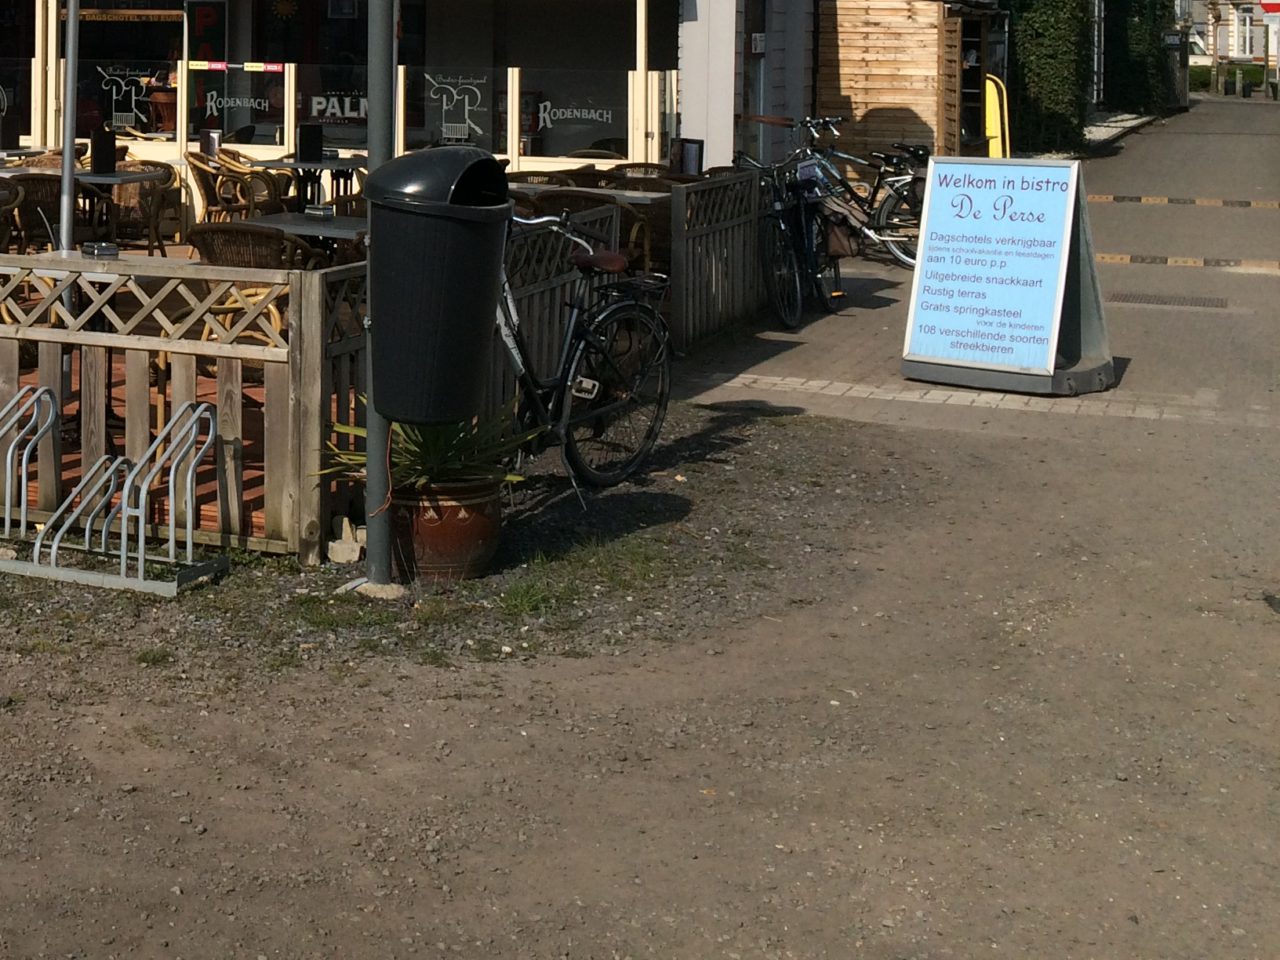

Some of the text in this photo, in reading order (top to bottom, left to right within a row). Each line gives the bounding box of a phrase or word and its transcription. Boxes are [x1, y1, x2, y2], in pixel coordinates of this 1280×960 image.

[85, 14, 138, 22] DAGSCHOTEL
[205, 91, 269, 119] RODENBACH
[537, 101, 612, 131] RODENBACH
[938, 173, 1069, 192] Welkom in bistro
[950, 193, 1046, 223] De Perse
[930, 231, 1057, 249] Dagschotels verkrijgbaar
[927, 255, 946, 264] aan
[950, 255, 962, 265] 10
[964, 258, 987, 267] euro
[925, 269, 1043, 288] Uitgebreide snackkaart
[922, 285, 987, 300] Rustig terras
[920, 300, 1022, 319] Gratis springkasteel
[918, 324, 1049, 345] 108 verschillende soorten
[996, 320, 1007, 328] de
[1009, 321, 1045, 331] kinderen
[950, 340, 1014, 354] streekbieren
